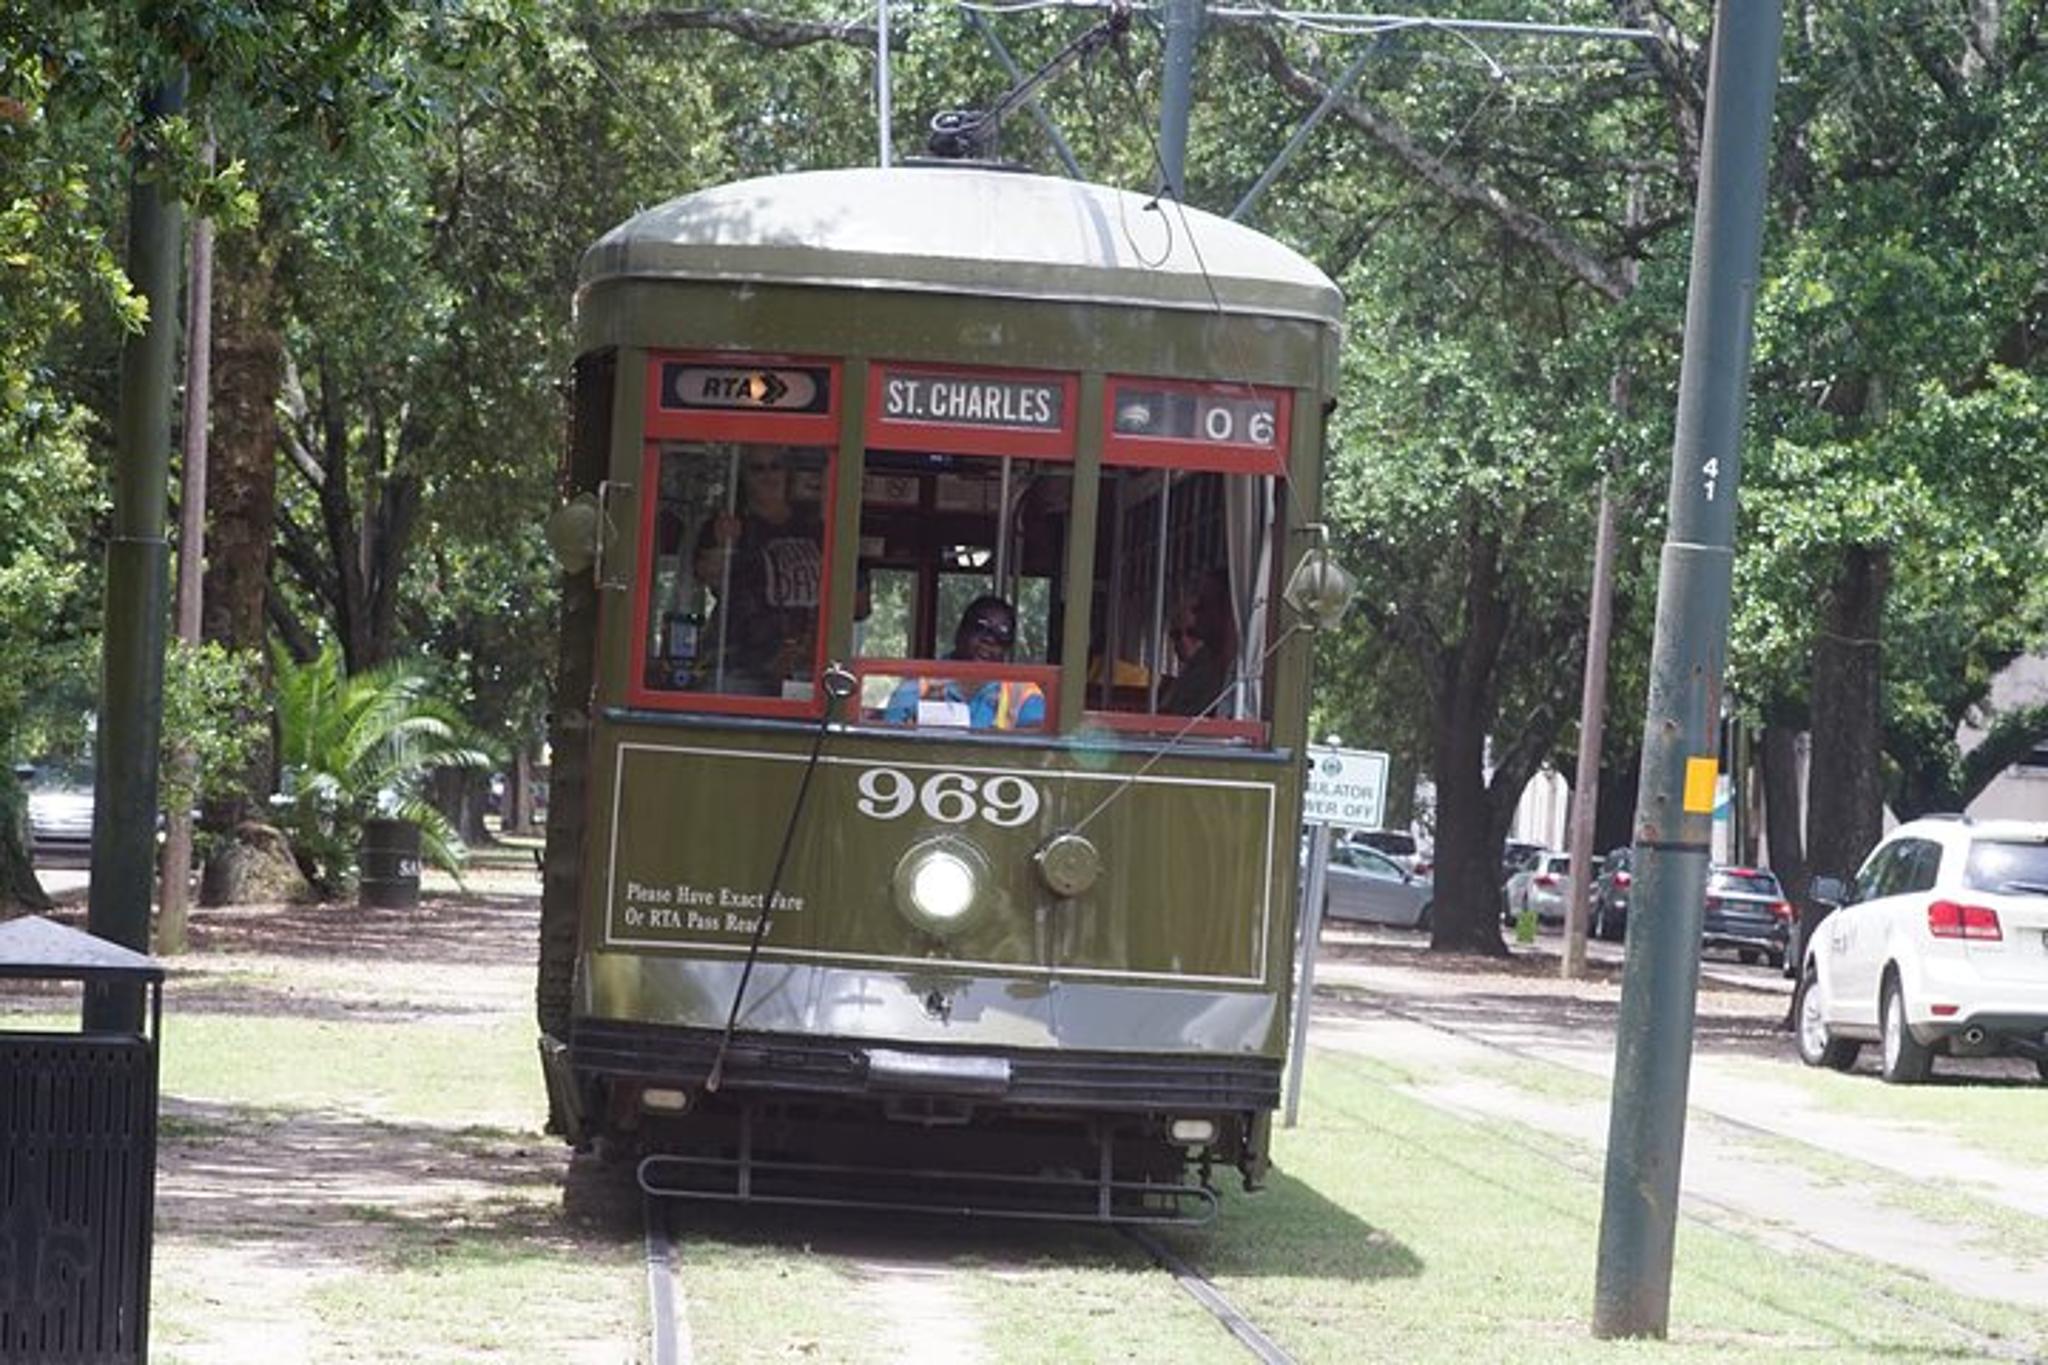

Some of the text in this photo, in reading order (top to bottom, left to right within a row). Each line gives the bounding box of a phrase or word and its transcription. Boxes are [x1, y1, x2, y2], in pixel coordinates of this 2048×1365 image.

[701, 376, 751, 399] RTA
[887, 379, 1051, 423] ST. CHARLES
[857, 766, 1040, 827] 969
[627, 882, 672, 903] Please
[677, 886, 715, 906] Have
[719, 887, 764, 909] Exact
[625, 906, 645, 926] Or
[650, 909, 682, 928] RTA
[687, 912, 720, 931] Pass
